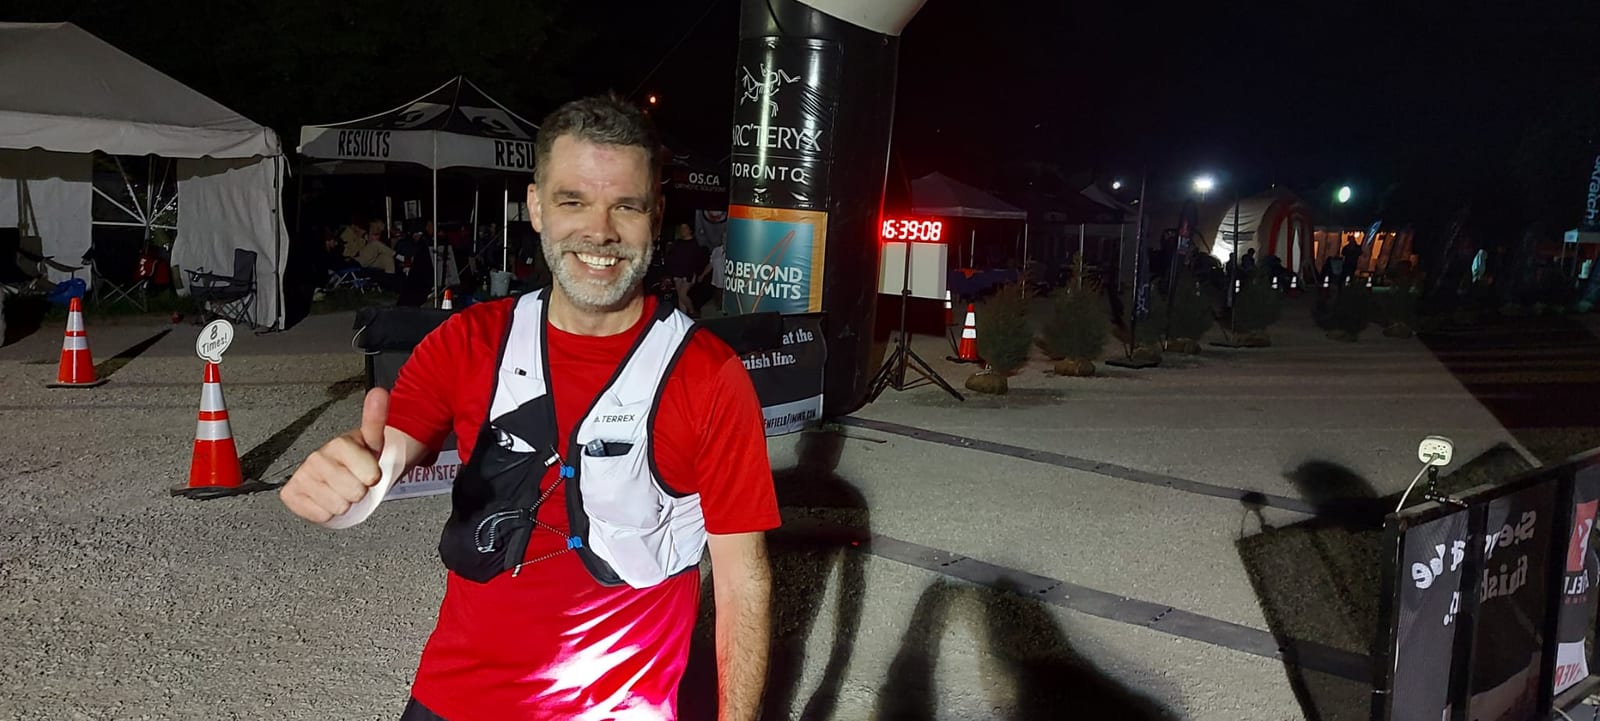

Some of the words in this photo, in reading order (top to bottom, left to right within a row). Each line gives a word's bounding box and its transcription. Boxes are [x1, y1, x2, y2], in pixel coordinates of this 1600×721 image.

[338, 130, 390, 158] RESULTS
[494, 140, 535, 170] RESU
[882, 219, 942, 241] 16:39:08
[736, 261, 803, 283] BEYOND
[725, 276, 744, 294] OUR
[748, 280, 801, 300] LIMITS
[202, 332, 227, 354] Times!
[210, 324, 218, 340] 8
[782, 331, 795, 345] at
[796, 328, 814, 343] the
[742, 353, 771, 370] nish
[602, 414, 635, 423] TERREX
